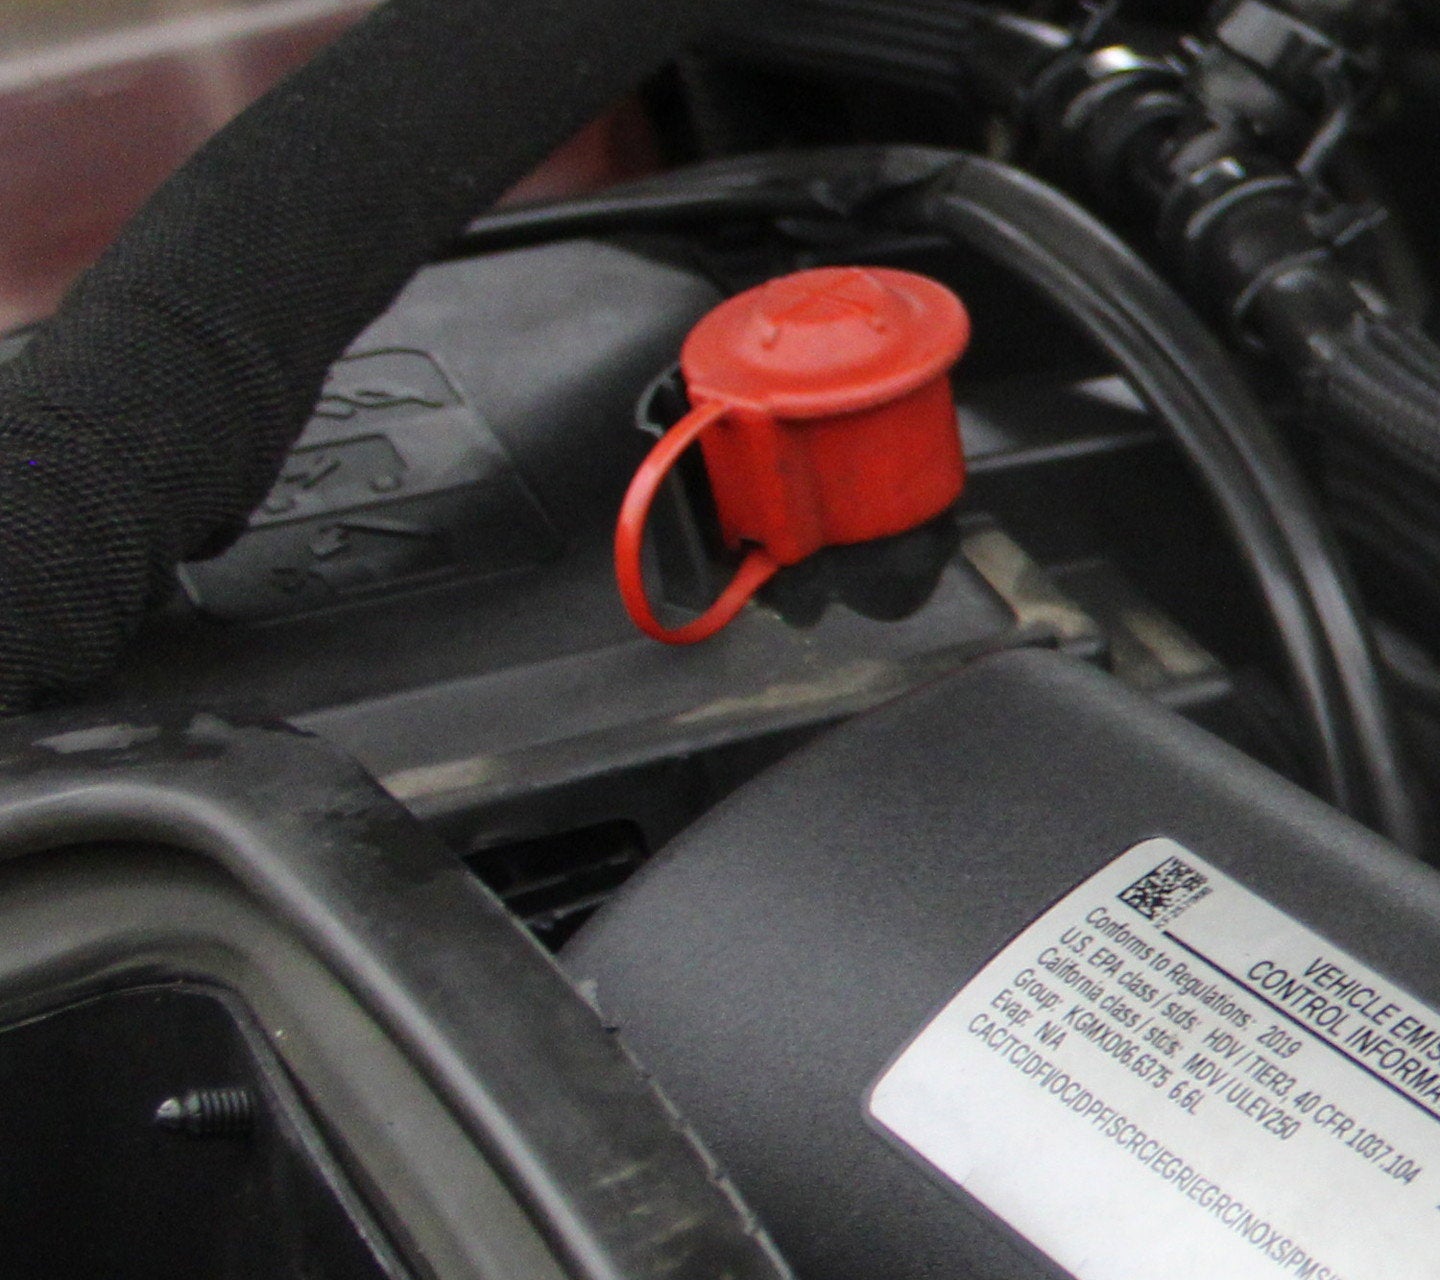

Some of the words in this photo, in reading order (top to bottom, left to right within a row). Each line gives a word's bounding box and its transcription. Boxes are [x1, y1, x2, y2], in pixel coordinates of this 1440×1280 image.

[987, 988, 1039, 1028] Evap:
[1005, 967, 1066, 1014] Group:
[1167, 1079, 1207, 1114] 6.6L
[1035, 946, 1107, 1002] California
[1098, 993, 1143, 1028] class
[1181, 1052, 1228, 1088] MDV
[1224, 1082, 1302, 1141] ULEV250
[1058, 926, 1095, 956] U.S.
[1087, 946, 1125, 977] EPA
[1116, 969, 1161, 1003] class
[1201, 1027, 1245, 1060] HDV
[1291, 1089, 1321, 1114] 40
[1311, 1103, 1356, 1138] CFR
[1344, 1127, 1422, 1185] 1037.104
[1084, 905, 1157, 960] Conforms
[1148, 951, 1173, 971] to
[1162, 961, 1258, 1032] Regulations:
[1255, 1023, 1303, 1059] 2019
[1245, 958, 1353, 1036] CONTROL
[1302, 957, 1401, 1026] VEHICLE
